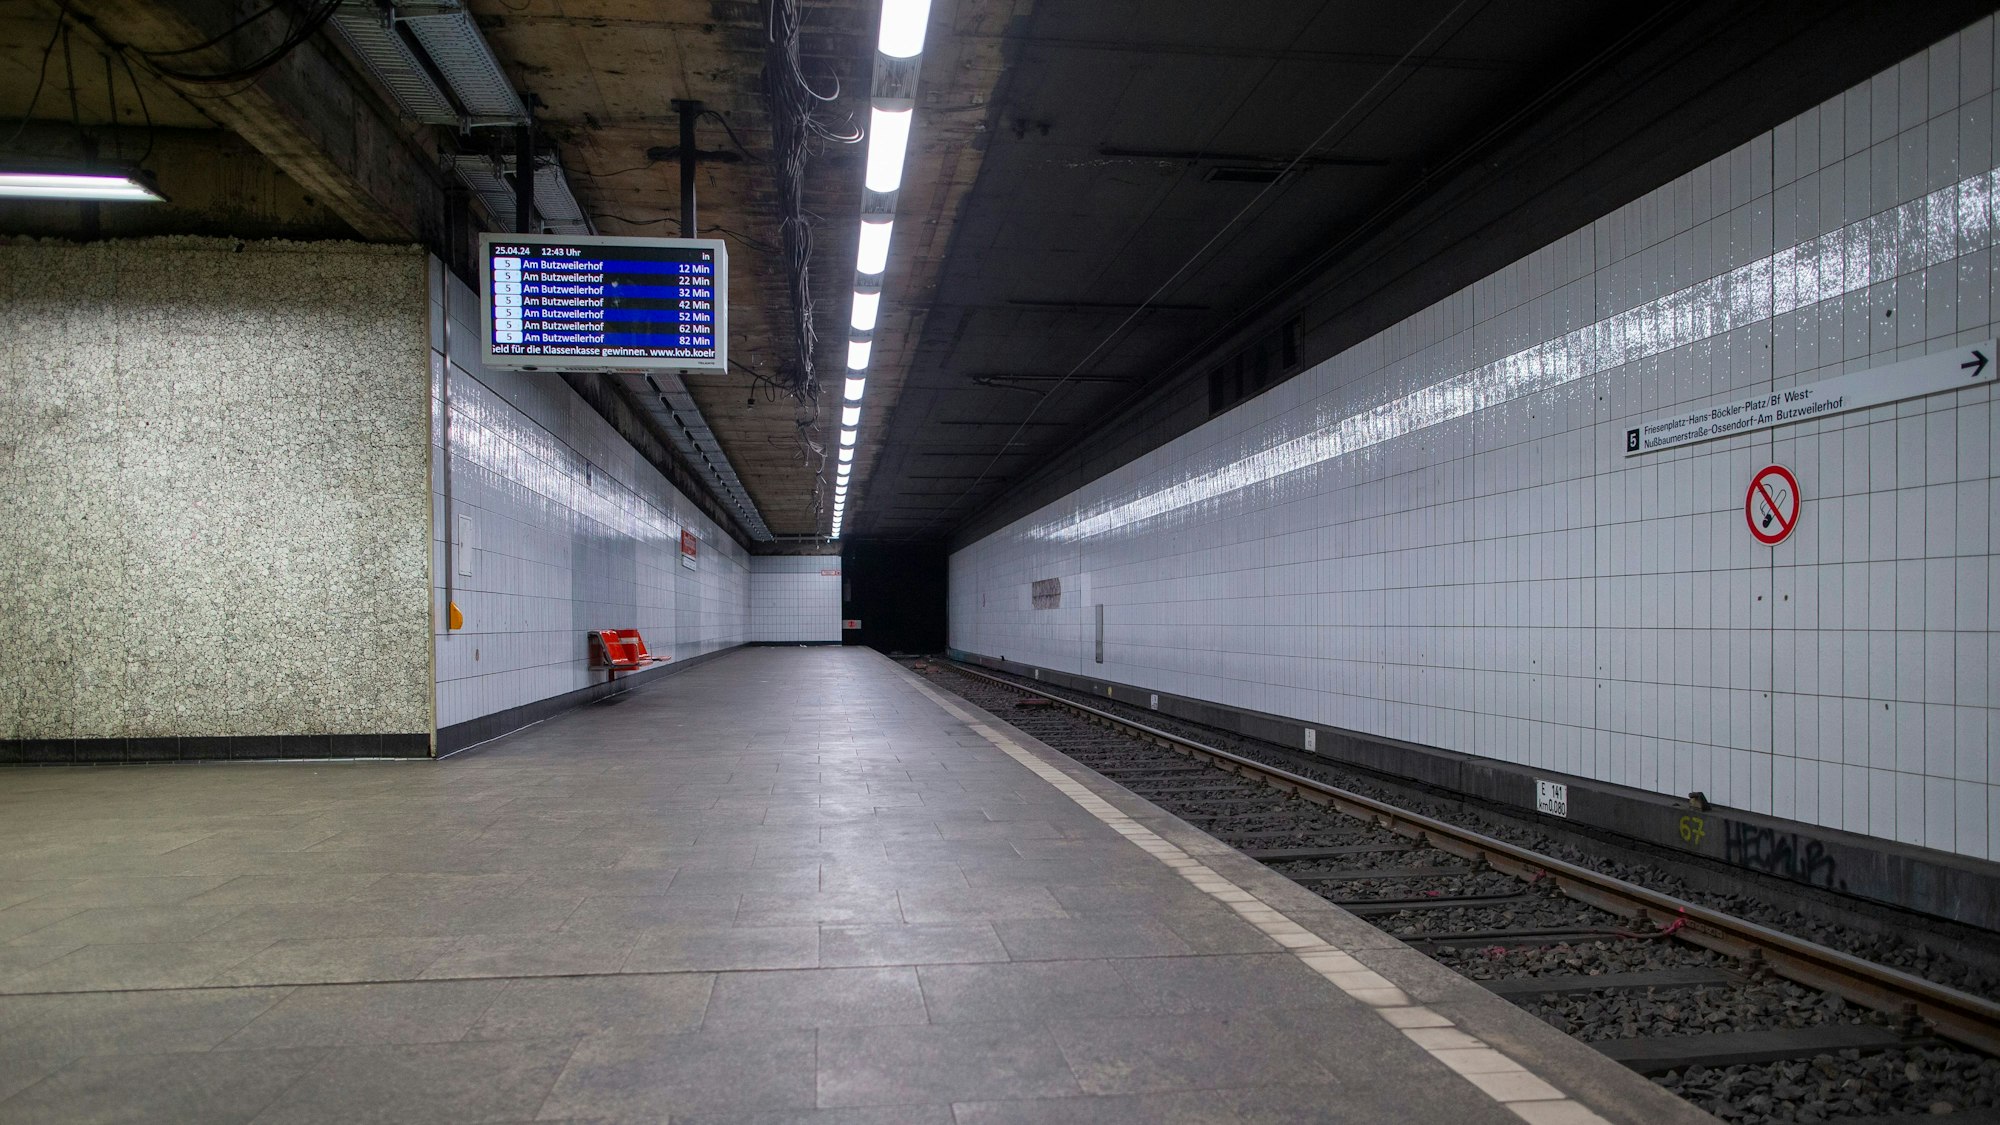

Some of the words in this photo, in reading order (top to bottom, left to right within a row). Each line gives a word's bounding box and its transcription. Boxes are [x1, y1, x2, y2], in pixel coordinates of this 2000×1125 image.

[495, 247, 530, 255] 25.04.24
[542, 247, 564, 256] 12:43
[566, 248, 581, 257] Uhr
[505, 260, 511, 268] 5
[523, 261, 538, 269] Am
[541, 261, 603, 270] Butzweilerhof
[679, 265, 690, 273] 12
[693, 265, 710, 274] Min
[505, 272, 511, 280] 5
[523, 273, 539, 281] Am
[542, 273, 603, 283] Butzweilerhof
[679, 277, 690, 285] 22
[693, 277, 710, 286] Min
[505, 284, 511, 292] 5
[524, 285, 539, 293] Am
[542, 285, 604, 295] Butzweilerhof
[679, 289, 690, 297] 32
[693, 289, 710, 298] Min
[506, 296, 511, 304] 5
[524, 297, 539, 306] Am
[542, 297, 604, 307] Butzweilerhof
[679, 301, 690, 309] 42
[693, 301, 710, 310] Min
[506, 308, 512, 316] 5
[524, 309, 539, 318] Am
[542, 309, 604, 319] Butzweilerhof
[679, 313, 690, 321] 52
[693, 313, 710, 322] Min
[506, 320, 512, 329] 5
[524, 322, 540, 330] Am
[542, 321, 604, 331] Butzweilerhof
[679, 325, 690, 333] 62
[693, 325, 710, 334] Min
[506, 333, 512, 341] 5
[525, 334, 540, 342] Am
[543, 334, 604, 343] Butzweilerhof
[679, 337, 690, 345] 82
[693, 337, 710, 346] Min
[511, 344, 525, 354] für
[527, 346, 541, 354] die
[543, 346, 600, 355] Klassenkasse
[602, 347, 648, 357] gewinnen.
[1784, 389, 1813, 403] West-
[1644, 415, 1773, 449] Nußbaumerstraße-Ossendorf-Am
[1776, 396, 1843, 421] Butzweilerhof
[1629, 432, 1637, 446] 5
[1541, 782, 1545, 796] E
[1552, 784, 1562, 800] 141
[1680, 816, 1705, 845] 67
